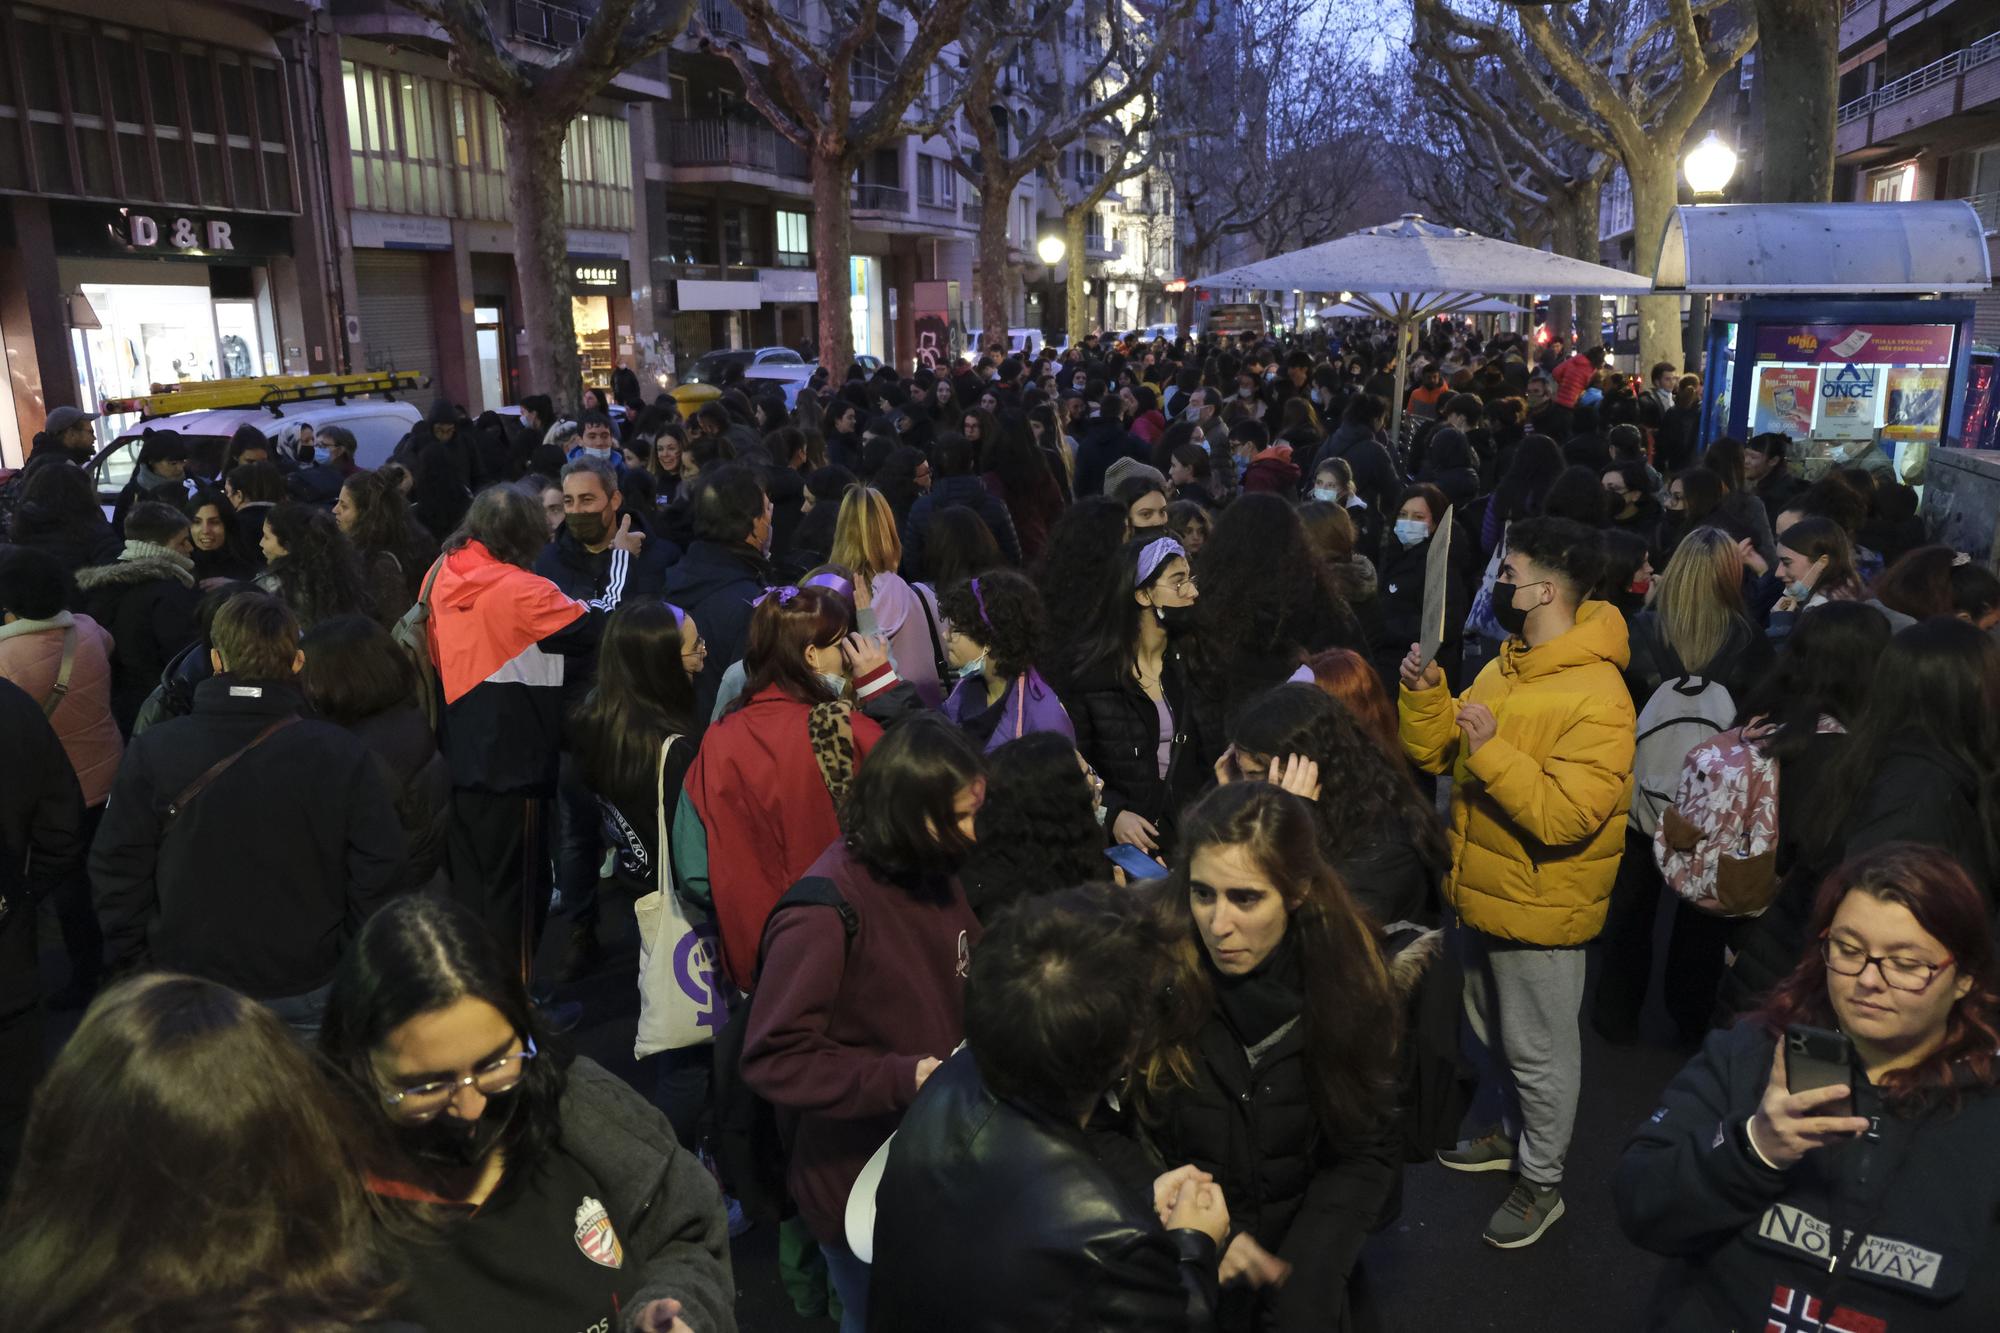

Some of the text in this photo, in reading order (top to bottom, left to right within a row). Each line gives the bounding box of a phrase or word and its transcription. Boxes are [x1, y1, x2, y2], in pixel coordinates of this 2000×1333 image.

[130, 216, 235, 250] D & R
[1821, 383, 1874, 398] ONCE
[1766, 1205, 1928, 1281] NOWAY
